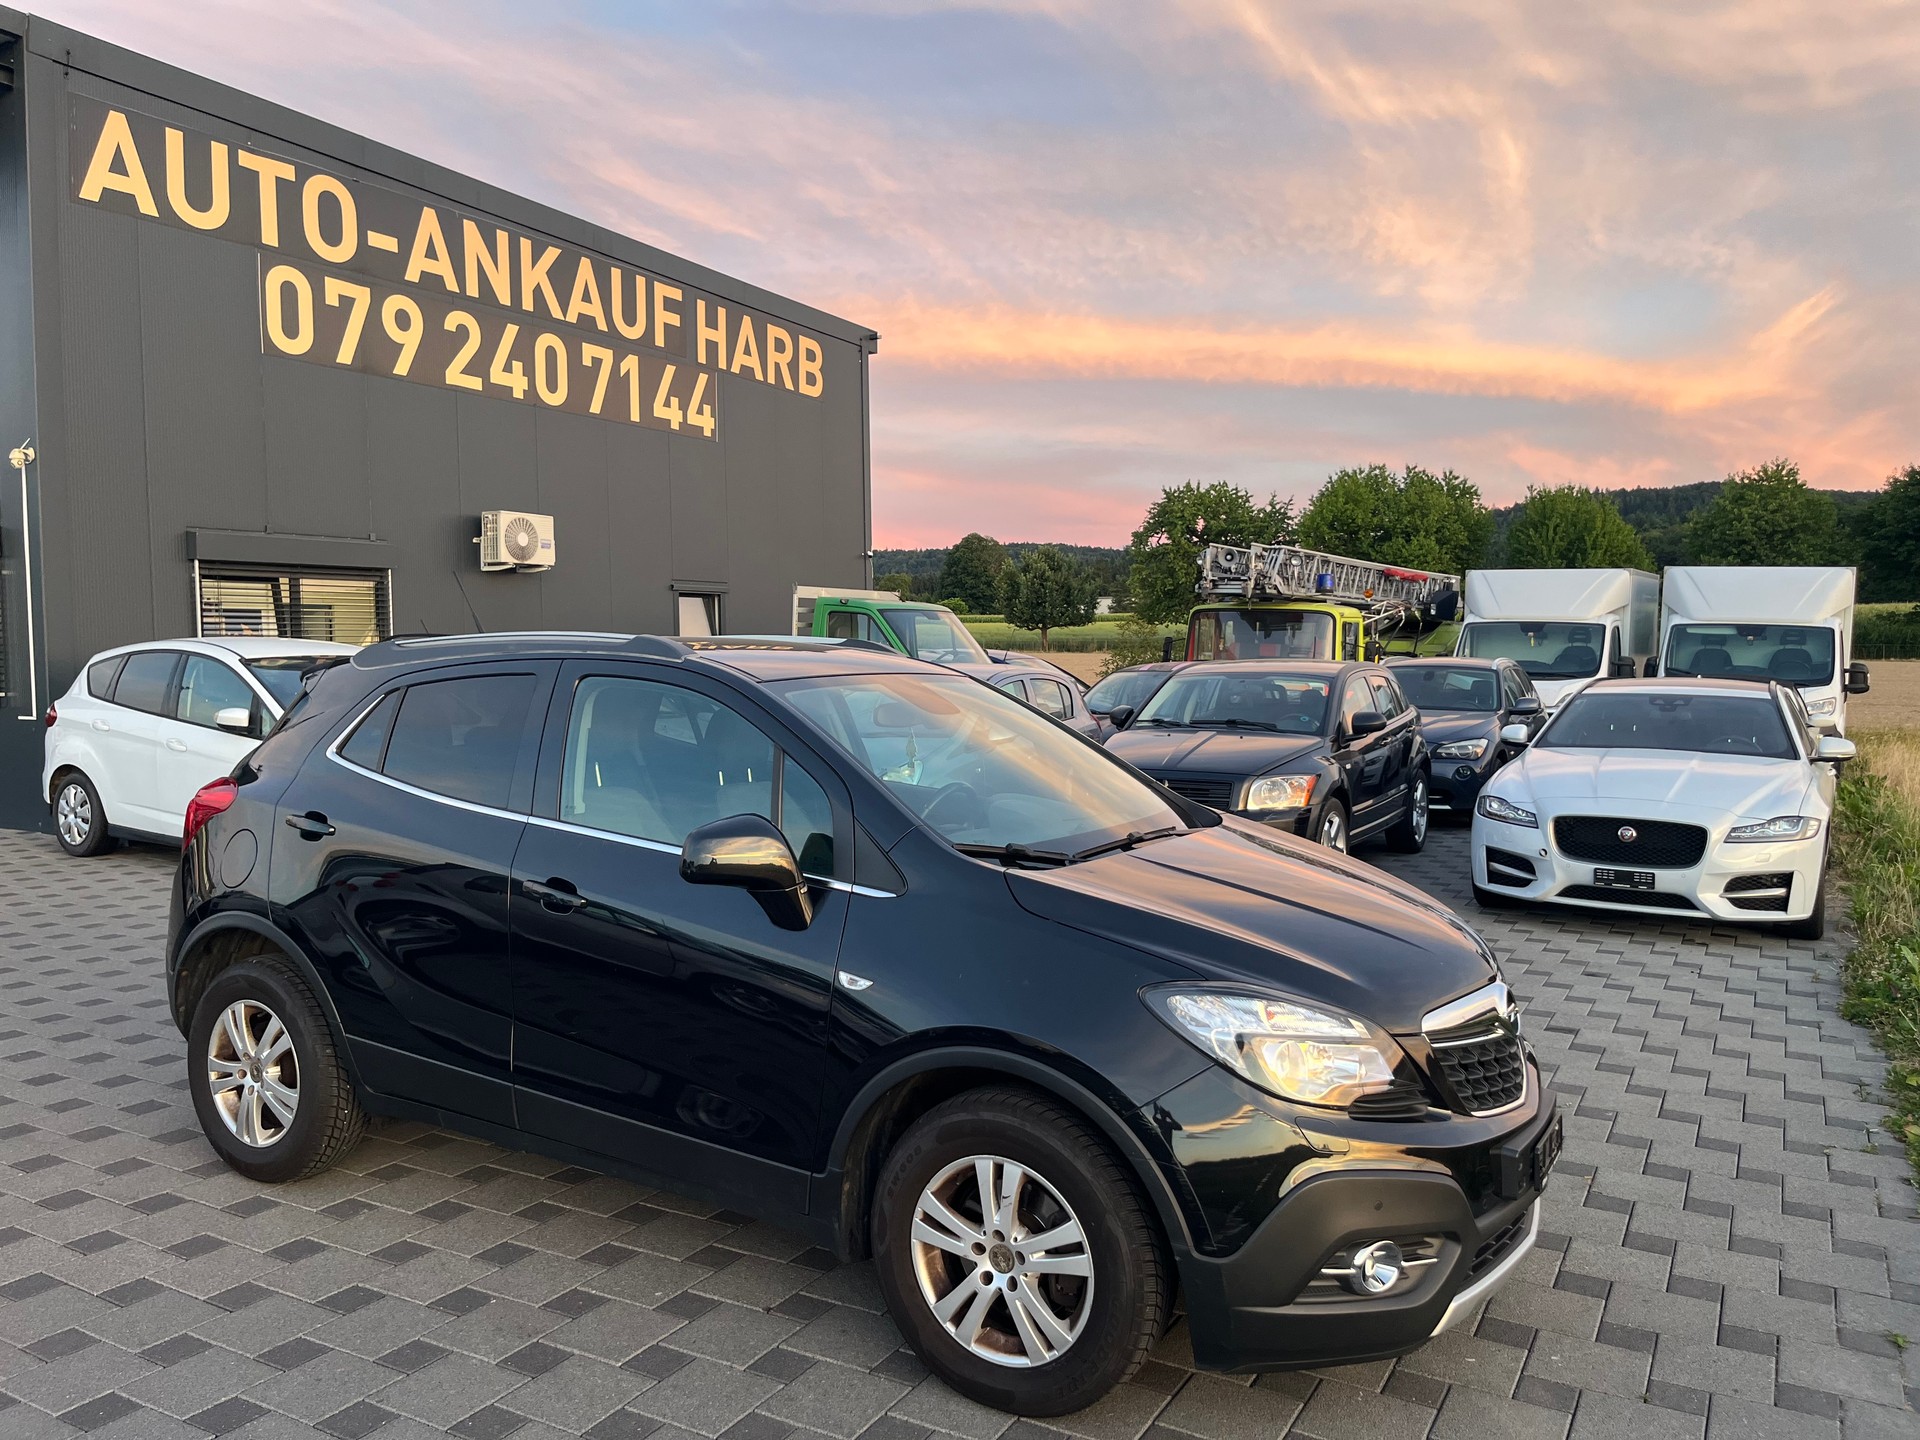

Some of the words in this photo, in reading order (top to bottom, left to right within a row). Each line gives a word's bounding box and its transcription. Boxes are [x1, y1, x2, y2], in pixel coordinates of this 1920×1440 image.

[79, 111, 683, 348] AUTO-ANKAUF
[694, 298, 824, 398] HARB
[264, 264, 424, 377] 079
[443, 310, 569, 407] 240
